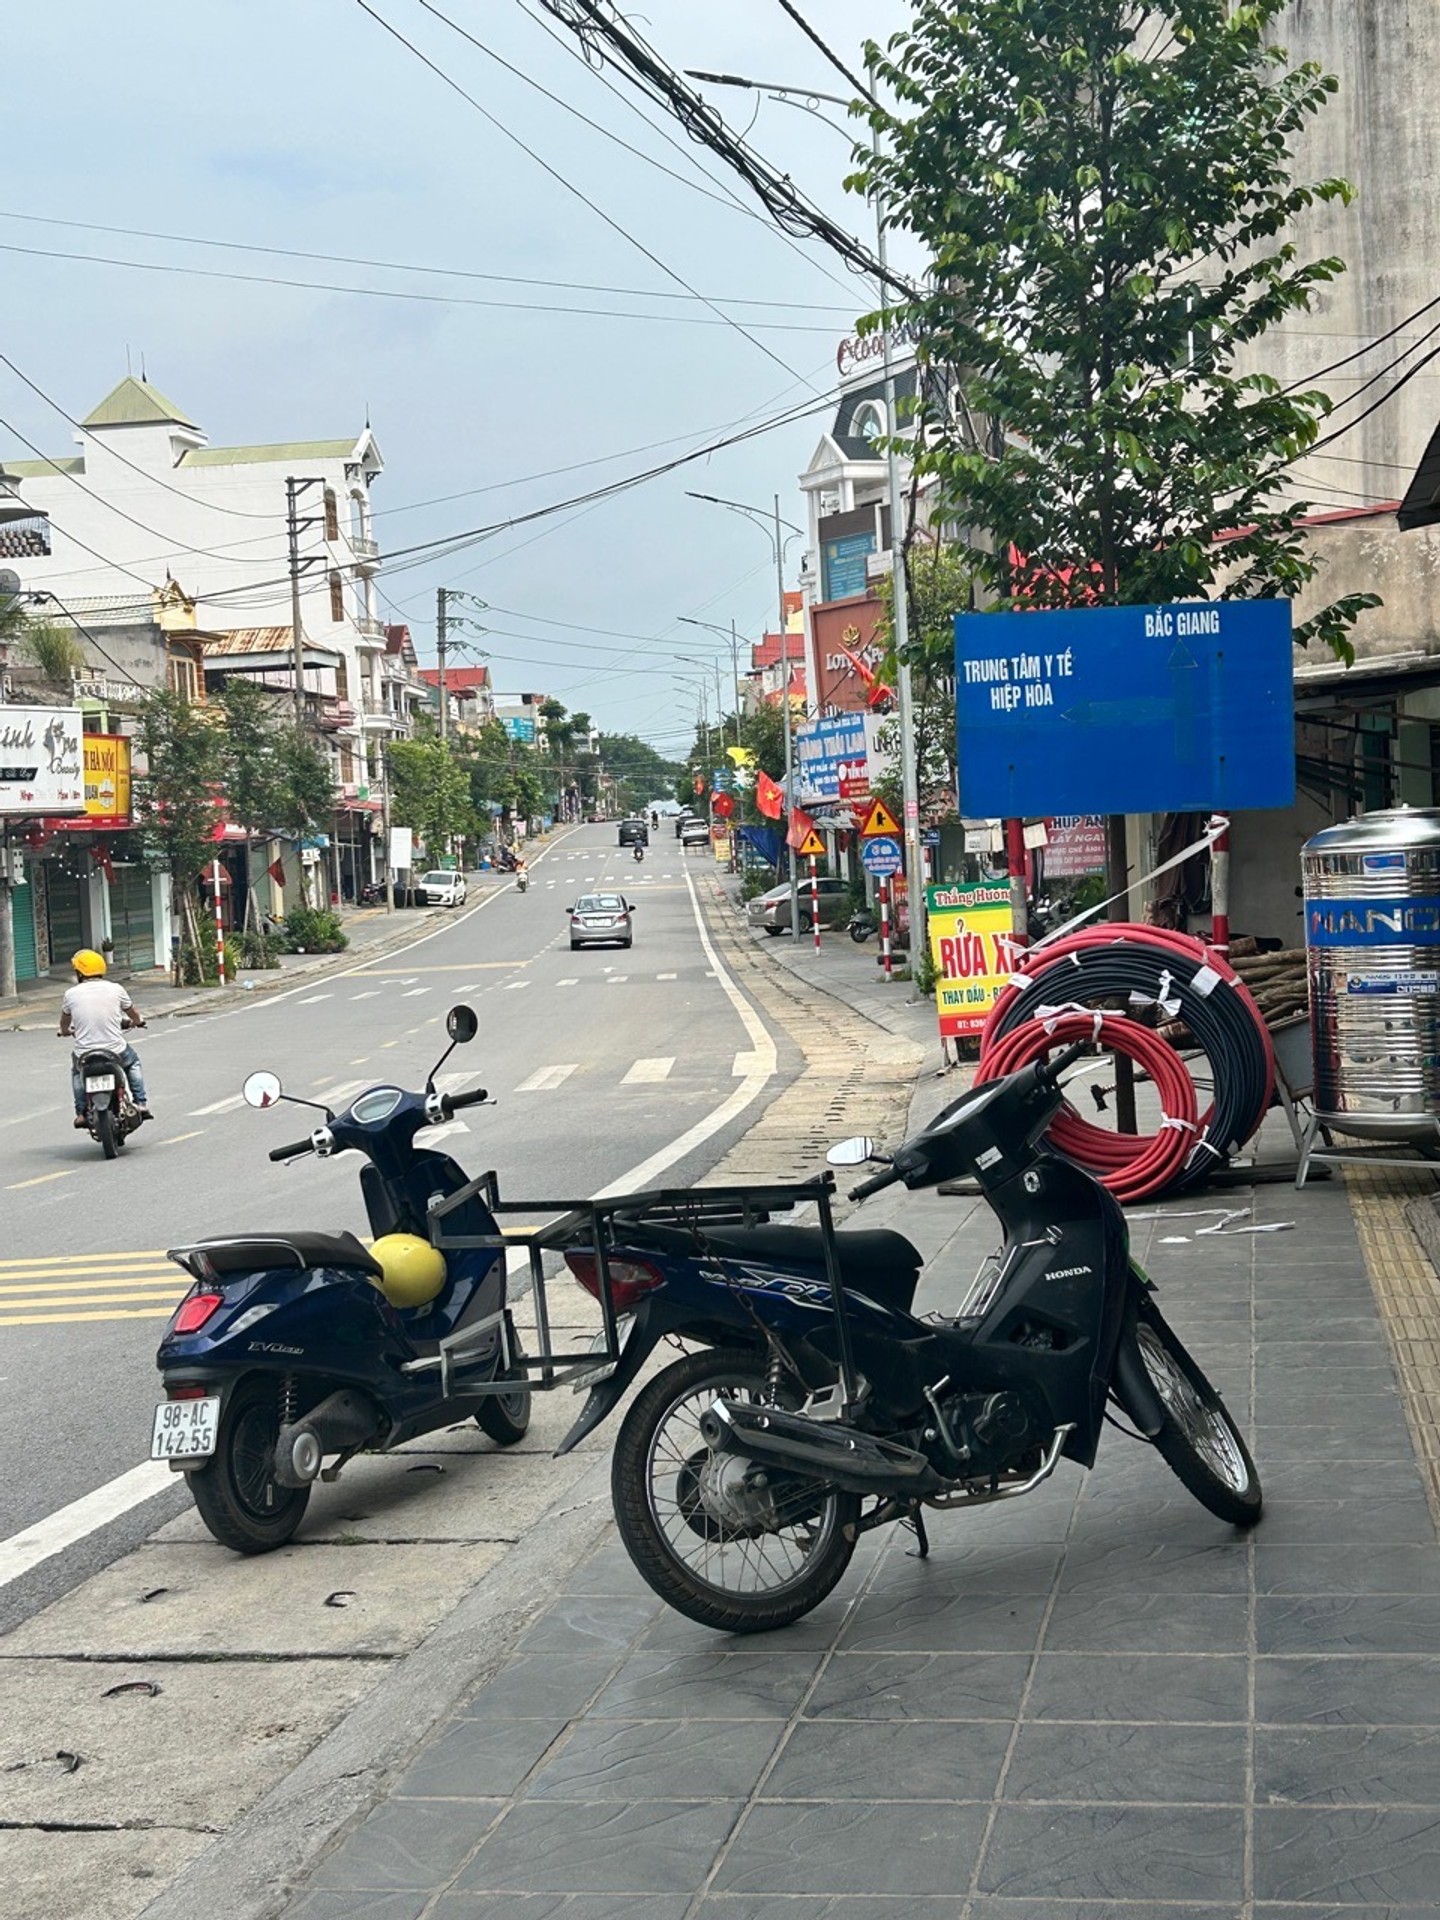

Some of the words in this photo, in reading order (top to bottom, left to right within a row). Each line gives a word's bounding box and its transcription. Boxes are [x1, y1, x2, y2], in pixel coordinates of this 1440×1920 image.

[1144, 607, 1173, 637] BẮC
[1177, 611, 1220, 636] GIANG
[963, 658, 1008, 684] TRUNG
[1011, 652, 1041, 681] TÂM
[1044, 655, 1053, 677] Y
[1056, 647, 1073, 676] TẾ
[990, 684, 1021, 712] HIỆP
[1025, 679, 1054, 708] HÒA
[940, 919, 988, 979] RỬA
[942, 989, 965, 1005] THAY
[1044, 1265, 1093, 1281] HONDA
[163, 1402, 210, 1429] 98-AC
[156, 1428, 213, 1457] 142.55
